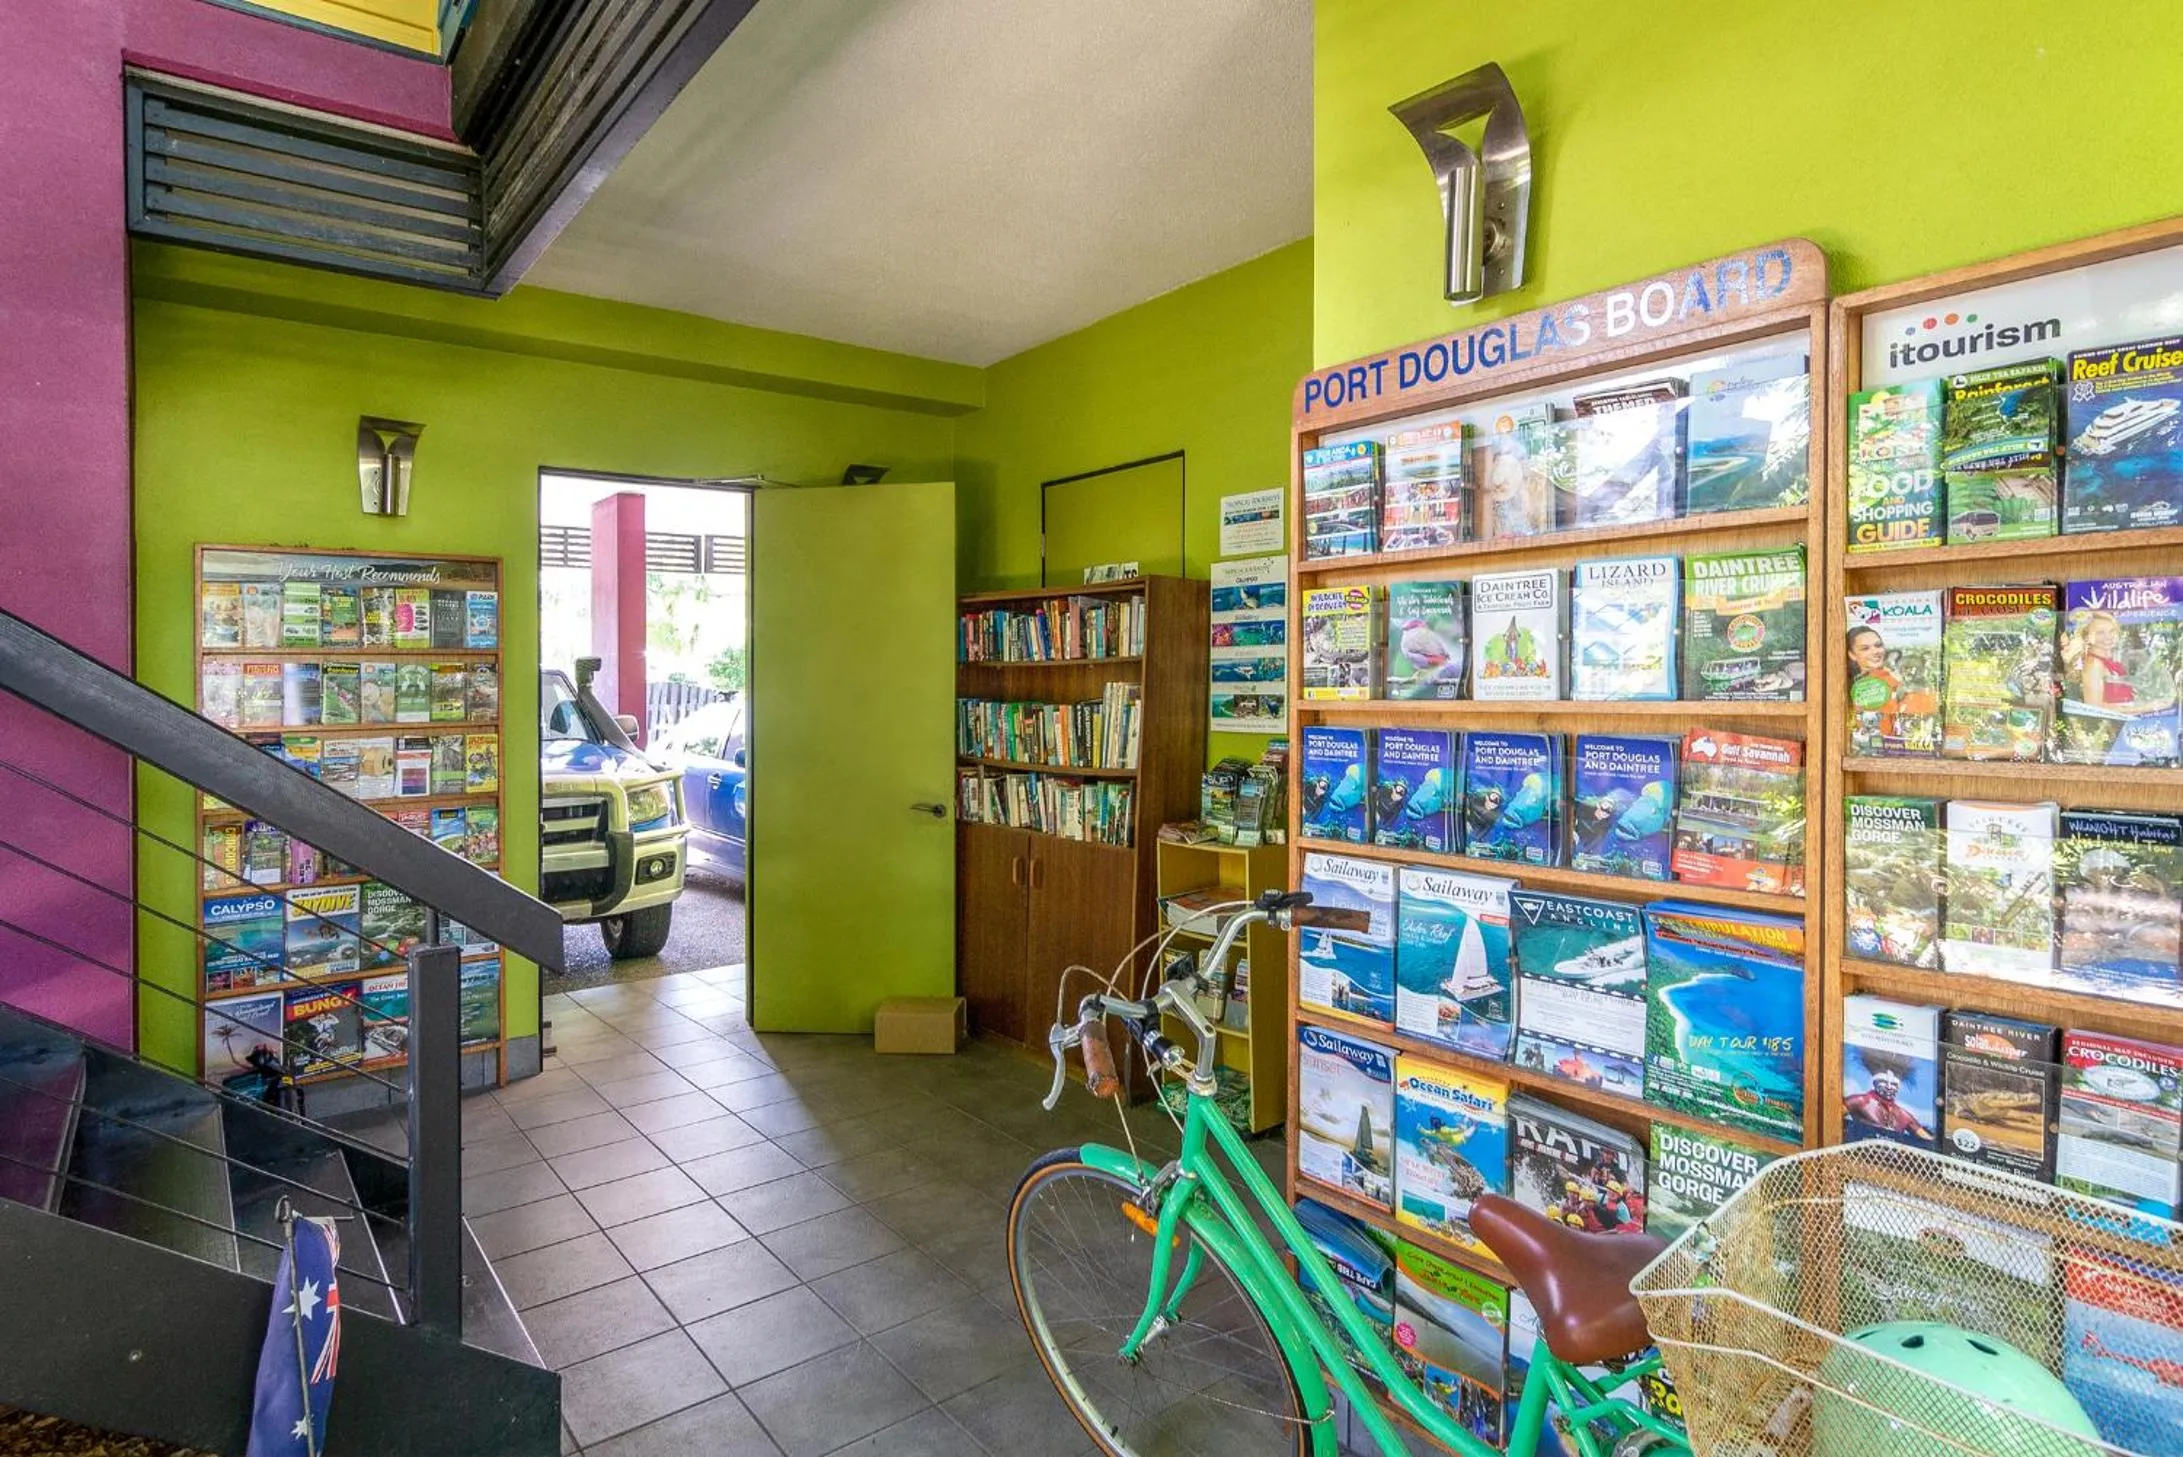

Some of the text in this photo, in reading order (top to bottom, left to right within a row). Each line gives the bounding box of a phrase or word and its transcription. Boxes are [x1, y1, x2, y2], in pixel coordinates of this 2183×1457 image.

[1304, 248, 1794, 413] PORT DOUGLAS BOARD
[1889, 317, 2061, 369] itourism
[2073, 352, 2119, 380] Reef
[1853, 501, 1934, 522] SHOPPING
[1856, 518, 1931, 545] GUIDE
[279, 561, 442, 585] Your Host Recommends
[1589, 562, 1667, 581] LIZARD
[1693, 555, 1801, 578] DAINTREE
[1480, 579, 1547, 593] DAINTREE
[1601, 577, 1654, 589] ISLAND
[1477, 593, 1493, 603] ICE
[1495, 591, 1531, 602] CREAM
[1955, 593, 2052, 606] CROCODILES
[1882, 604, 1933, 616] KOALA
[1308, 740, 1359, 750] PORT DOUGLAS
[1308, 749, 1358, 758] AND DAINTREE
[1385, 742, 1440, 753] PORT DOUGLAS
[1475, 746, 1539, 757] PORT DOUGLAS
[1384, 751, 1439, 762] AND DAINTREE
[1475, 755, 1539, 767] AND DAINTREE
[1585, 751, 1660, 764] PORT DOUGLAS
[1742, 746, 1791, 764] Savannah
[1584, 760, 1660, 773] AND DAINTREE
[1850, 805, 1922, 820] DISCOVER
[1850, 817, 1925, 832] MOSSMAN
[1850, 830, 1902, 843] GORGE
[1323, 857, 1379, 884] Sailaway
[1423, 876, 1493, 902] Sailaway
[211, 899, 276, 916] CALYPSO
[1546, 900, 1633, 922] EASTCOAST
[1550, 913, 1636, 933] ANGLING
[1951, 1020, 2041, 1041] DAINTREE RIVER
[1319, 1034, 1375, 1064] Sailaway
[1688, 1035, 1794, 1051] DAY TOUR $185
[2068, 1046, 2178, 1077] CROCODILES
[2020, 1067, 2046, 1078] Cruise
[1409, 1077, 1493, 1111] Ocean Safari
[1659, 1133, 1759, 1175] DISCOVER
[1658, 1171, 1725, 1206] GORGE
